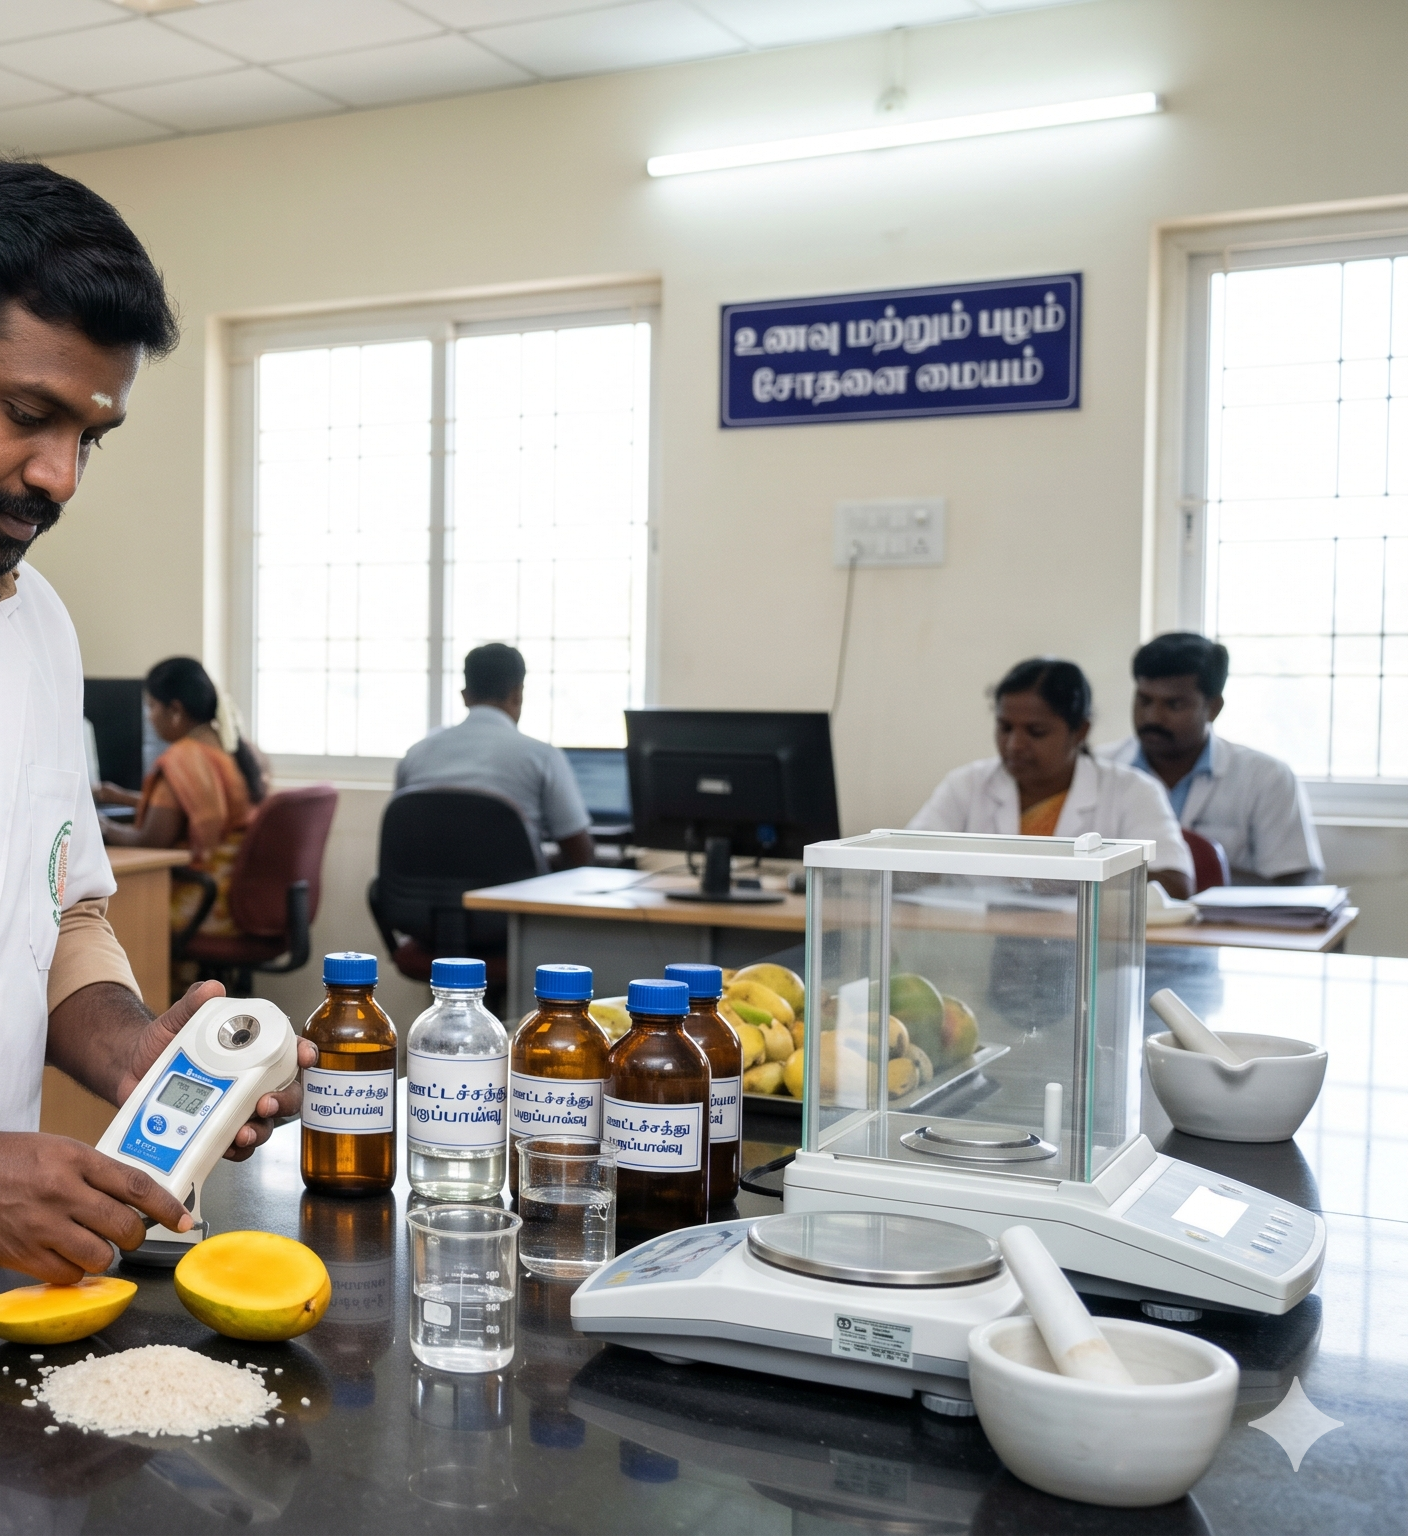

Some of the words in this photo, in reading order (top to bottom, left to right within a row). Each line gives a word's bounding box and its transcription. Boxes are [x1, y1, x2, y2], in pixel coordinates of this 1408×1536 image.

[734, 321, 840, 356] உணவு
[846, 299, 972, 356] மற்றும்
[978, 290, 1066, 345] பழம்
[752, 365, 910, 407] சோதனை
[915, 344, 1044, 392] மையம்
